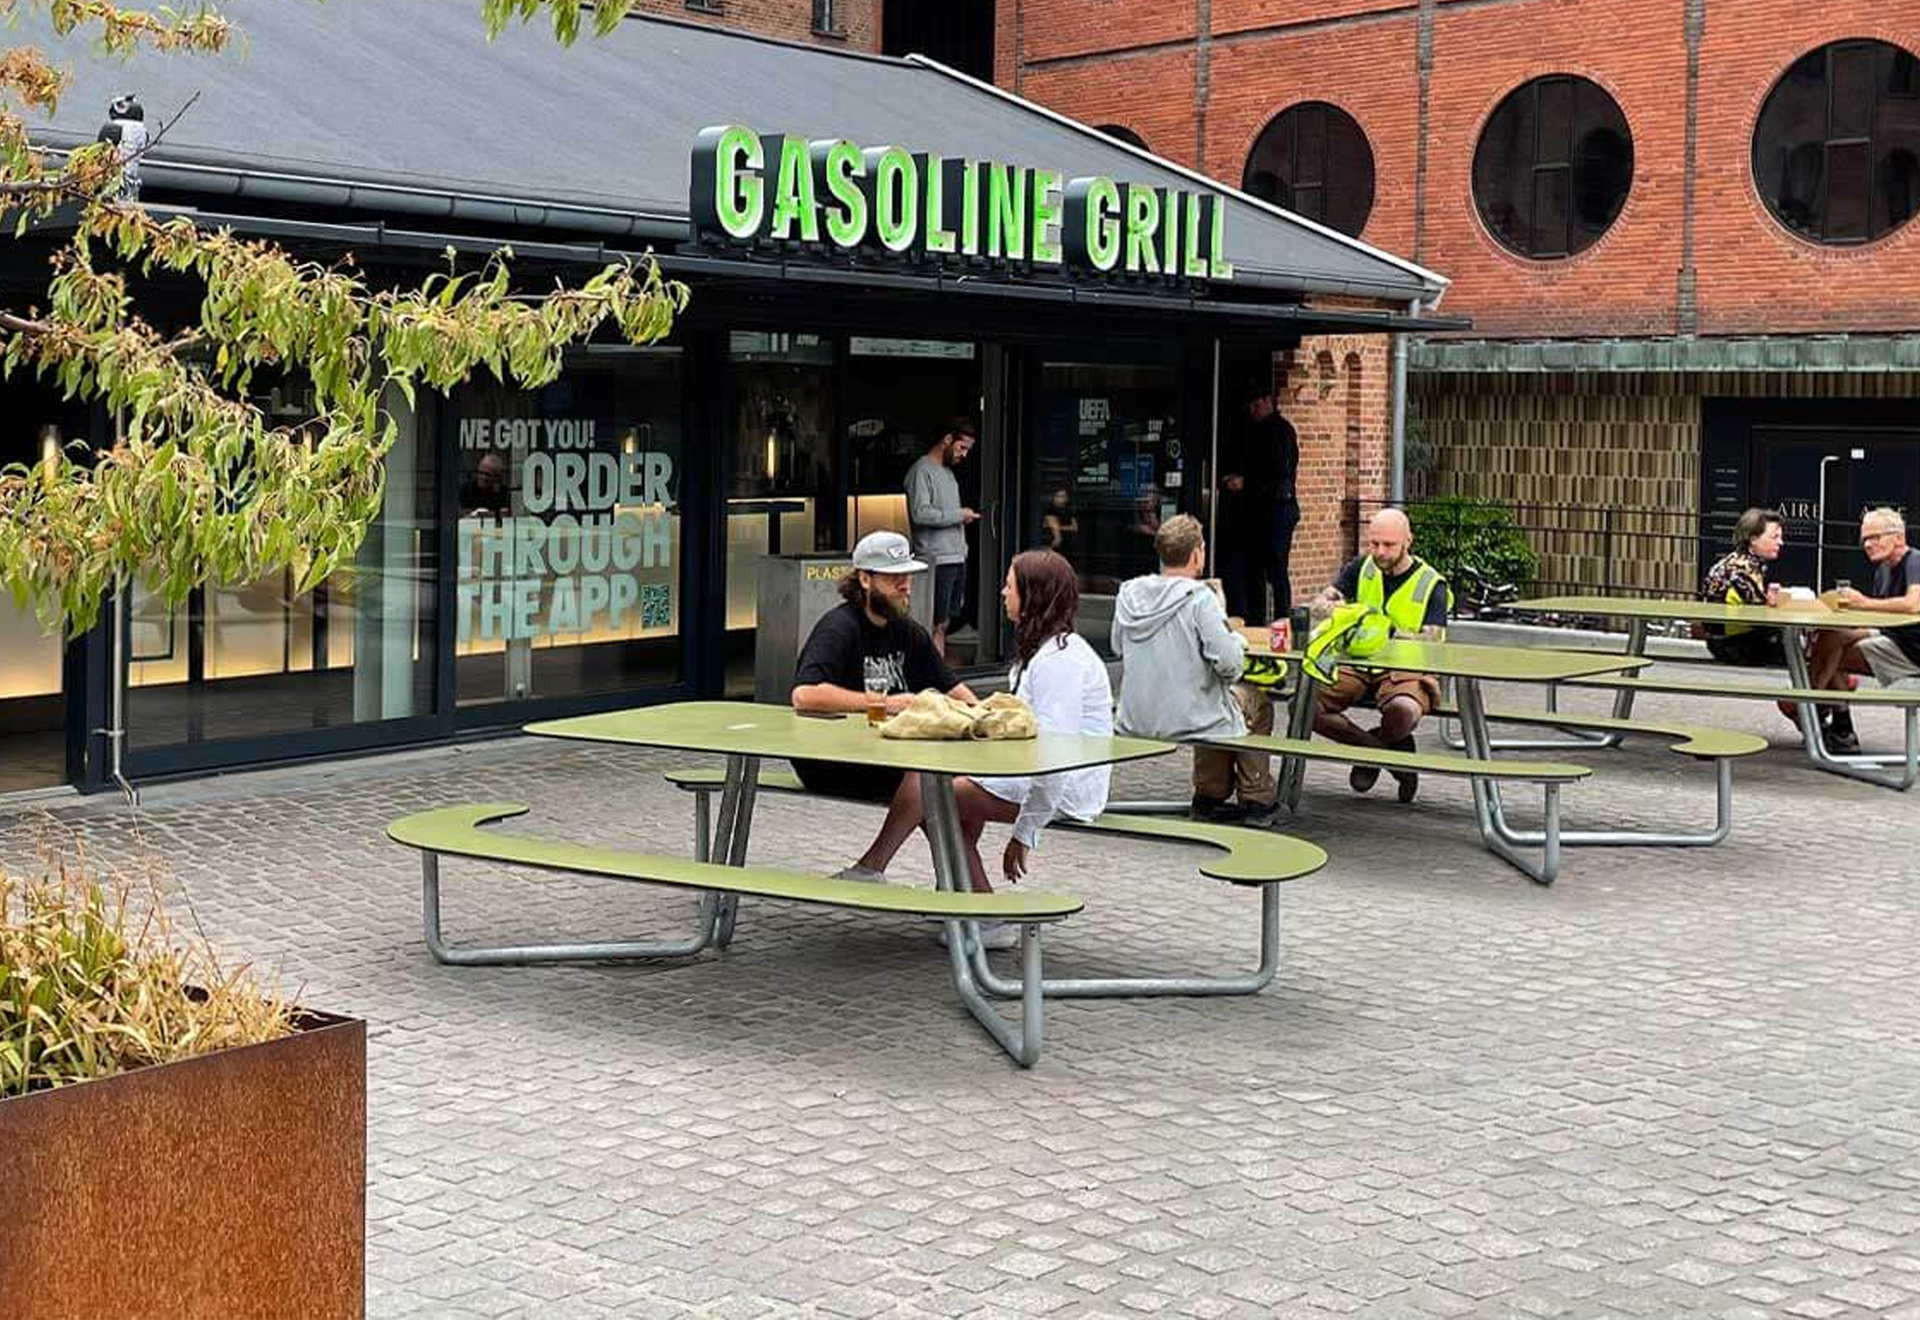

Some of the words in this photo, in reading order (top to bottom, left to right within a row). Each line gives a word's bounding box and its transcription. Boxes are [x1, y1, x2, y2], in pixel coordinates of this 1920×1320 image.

[712, 123, 1064, 265] GASOLINE
[1084, 175, 1234, 281] GRILL
[494, 418, 542, 450] GOT
[544, 419, 596, 450] YOU!
[521, 451, 676, 514] ORDER
[457, 513, 671, 580] THROUGH
[457, 577, 541, 642] THE
[551, 573, 639, 634] APP
